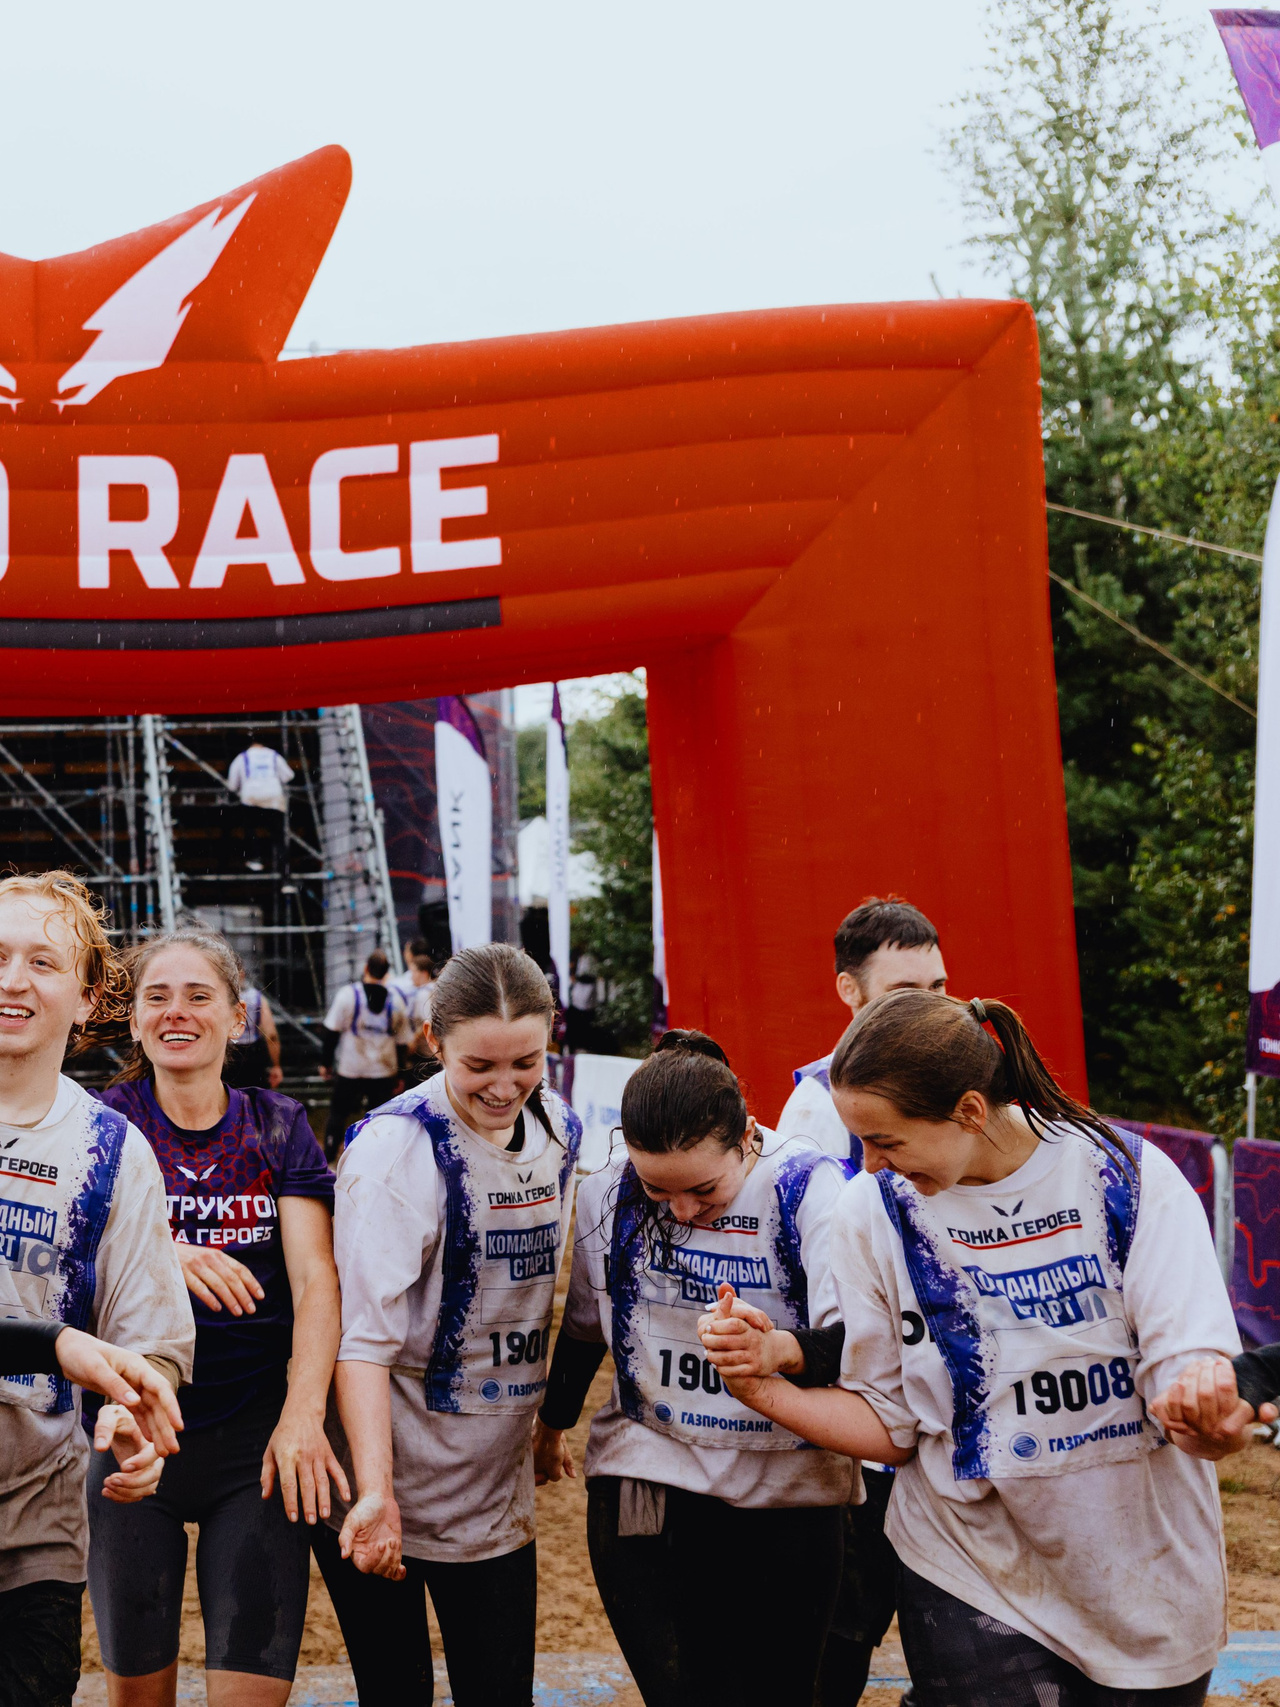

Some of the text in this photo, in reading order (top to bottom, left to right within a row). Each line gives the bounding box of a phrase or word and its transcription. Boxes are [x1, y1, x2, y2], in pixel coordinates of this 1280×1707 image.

[77, 433, 502, 589] RACE
[166, 1193, 277, 1220] ТРУКТО
[488, 1192, 523, 1205] ГОНКА
[710, 1215, 759, 1230] ЕРОЕВ
[947, 1208, 1081, 1244] ГОНКА ГЕРОЕВ
[513, 1253, 550, 1278] СТАРТ
[686, 1278, 720, 1303] СТА
[659, 1349, 734, 1398] 190
[1009, 1357, 1135, 1415] 19008
[681, 1411, 773, 1432] ГАЗПРОМБАНК
[1048, 1420, 1144, 1452] ГАЗПРОМБАНК
